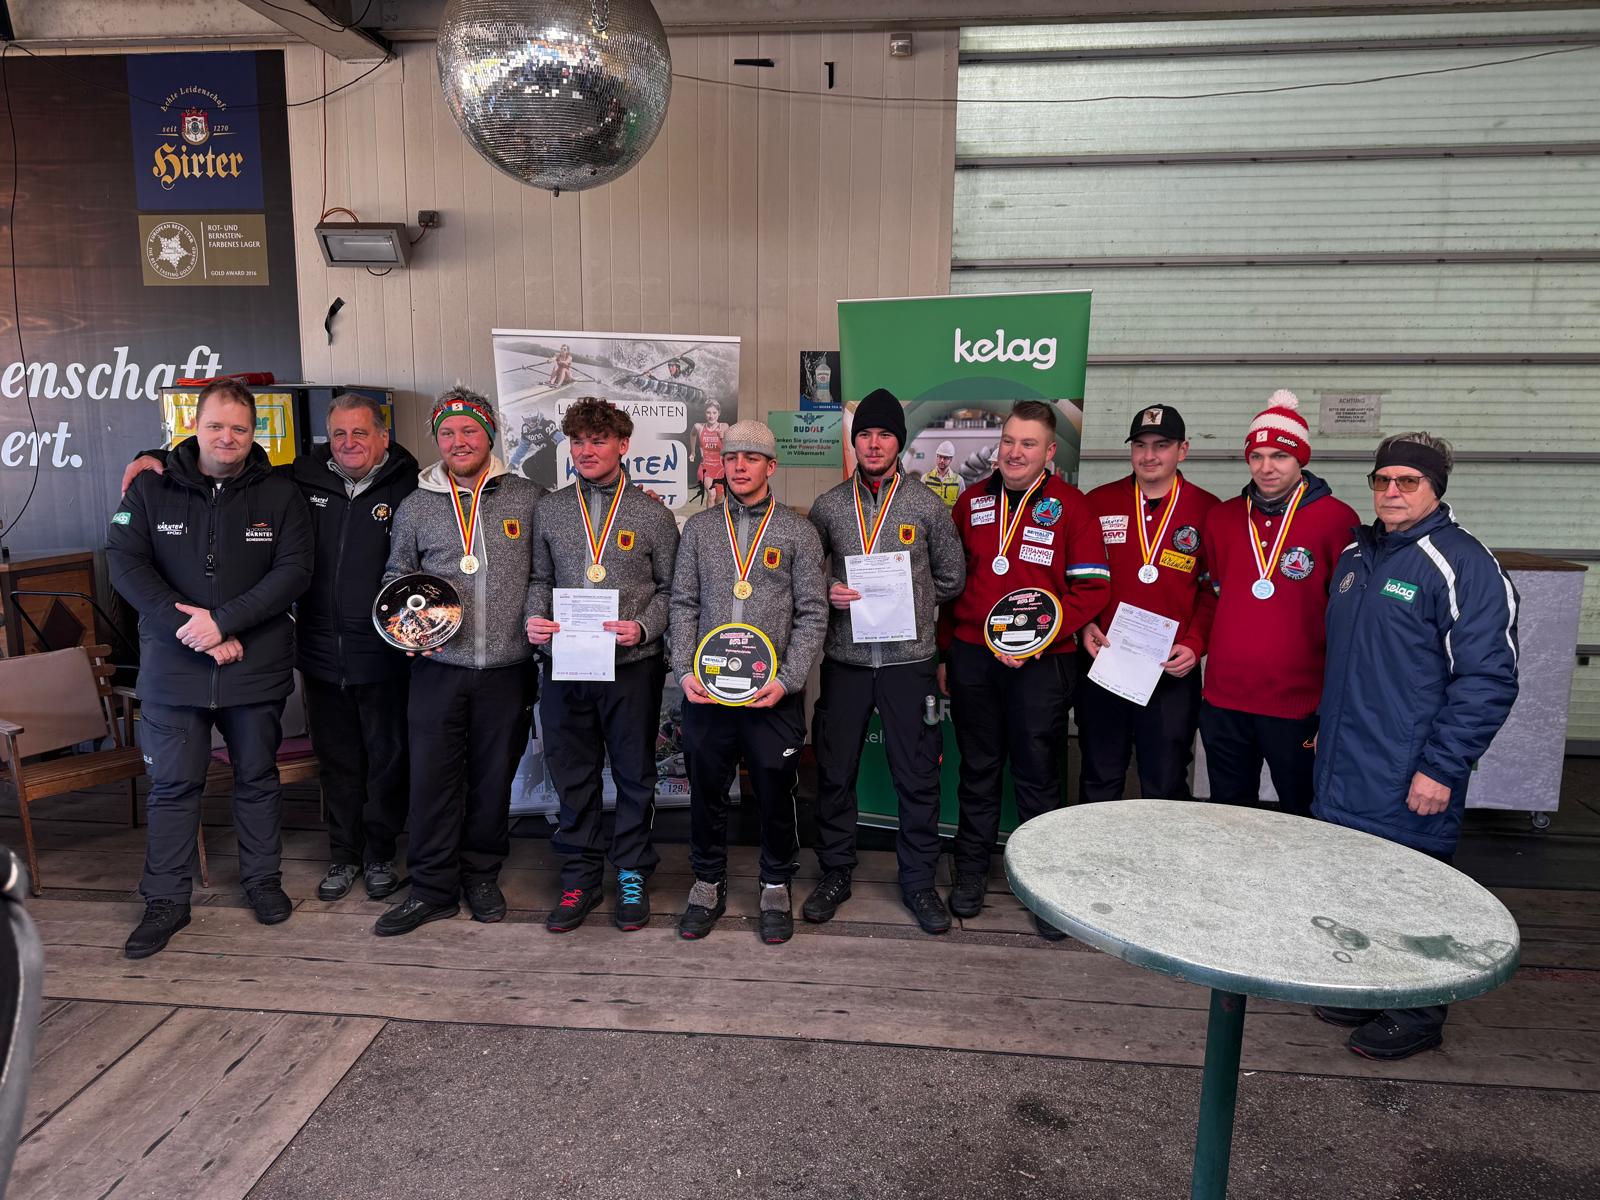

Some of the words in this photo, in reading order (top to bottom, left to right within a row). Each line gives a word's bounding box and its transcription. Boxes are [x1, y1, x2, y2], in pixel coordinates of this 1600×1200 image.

[180, 85, 227, 112] Leidenschaft
[152, 142, 243, 190] Hirter
[240, 240, 261, 248] LAGER
[954, 327, 1057, 370] kelag
[793, 425, 825, 433] RUDOLF
[0, 421, 83, 468] ert.
[1384, 579, 1415, 600] kelag
